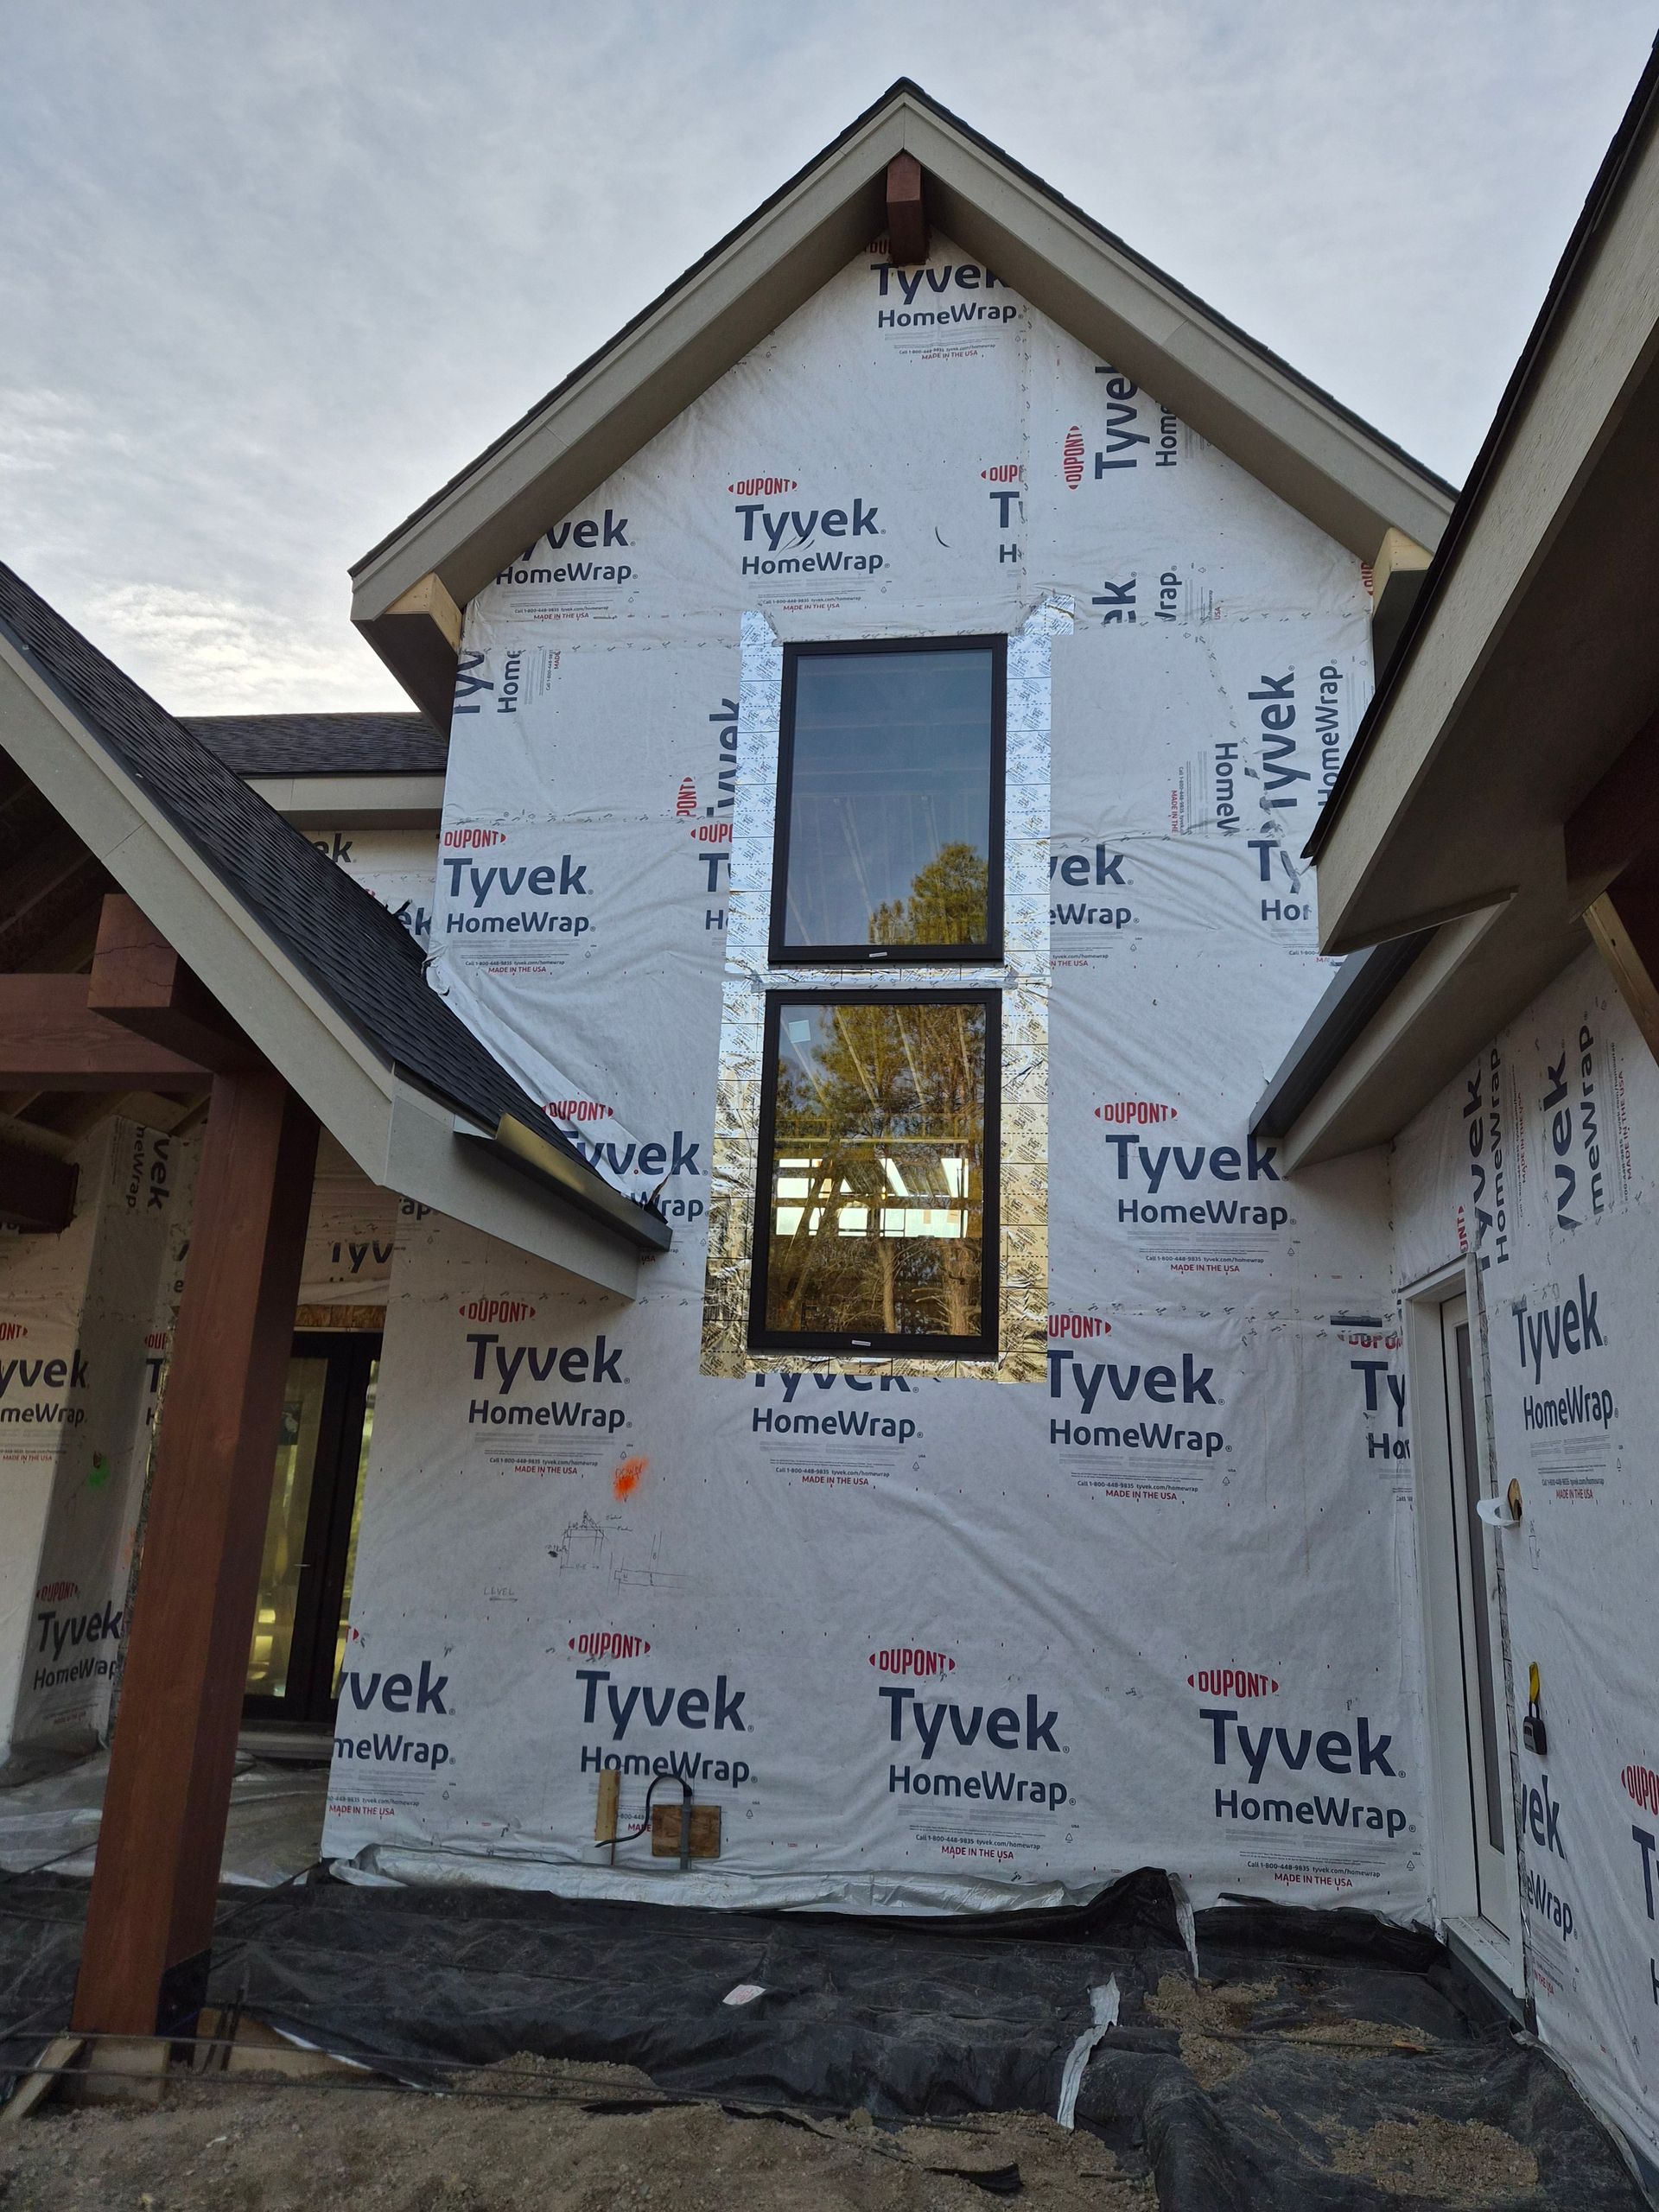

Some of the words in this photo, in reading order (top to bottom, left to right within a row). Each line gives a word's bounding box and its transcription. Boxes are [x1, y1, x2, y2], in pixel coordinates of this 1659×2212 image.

[878, 302, 1017, 327] HomeWrap
[1064, 433, 1084, 482] DUPONT
[737, 478, 790, 495] DUPONT
[735, 498, 879, 551] Tyvek
[497, 563, 632, 585] HomeWrap
[742, 551, 883, 575] HomeWrap
[444, 830, 499, 849] DUPONT
[443, 855, 587, 907] Tyvek
[446, 912, 589, 937] HomeWrap
[549, 1101, 606, 1121] DUPONT
[1104, 1102, 1168, 1124] DUPONT
[1623, 1126, 1629, 1139] IN
[1106, 1134, 1280, 1194] Tyvek
[1491, 1048, 1509, 1263] HomeWrap
[1118, 1199, 1287, 1230] HomeWrap
[468, 1300, 528, 1323] DUPONT
[1512, 1274, 1604, 1385] Tyvek
[467, 1333, 622, 1395] Tyvek
[1047, 1350, 1217, 1414] Tyvek
[469, 1400, 625, 1433] HomeWrap
[1523, 1385, 1612, 1431] HomeWrap
[753, 1408, 915, 1443] HomeWrap
[1050, 1419, 1224, 1458] HomeWrap
[1136, 1484, 1198, 1492] tyvek.com/homewrap
[1556, 1489, 1568, 1500] MADE
[1570, 1489, 1574, 1499] IN
[1574, 1489, 1583, 1499] THE
[1584, 1488, 1593, 1499] USA
[38, 1600, 123, 1662] Tyvek
[578, 1633, 642, 1659] DUPONT
[880, 1649, 946, 1676] DUPONT
[1198, 1669, 1268, 1698] DUPONT
[575, 1669, 746, 1740] Tyvek
[879, 1687, 1060, 1759] Tyvek
[1199, 1708, 1396, 1784] Tyvek
[581, 1745, 749, 1789] HomeWrap
[889, 1764, 1067, 1811] HomeWrap
[329, 1805, 352, 1814] MADE
[1215, 1789, 1406, 1838] HomeWrap
[928, 1835, 974, 1844] 1-800-448-9835
[976, 1840, 1040, 1850] tyvek.com/homewrap
[942, 1846, 966, 1855] MADE
[968, 1847, 976, 1856] IN
[979, 1849, 995, 1858] THE
[997, 1850, 1014, 1859] USA
[1260, 1862, 1310, 1872] 1-800-448-9835
[1313, 1866, 1381, 1878] tyvek.com/homewrap
[1274, 1872, 1300, 1883] MADE
[1303, 1875, 1313, 1884] IN
[1314, 1876, 1332, 1885] THE
[1334, 1878, 1352, 1887] USA
